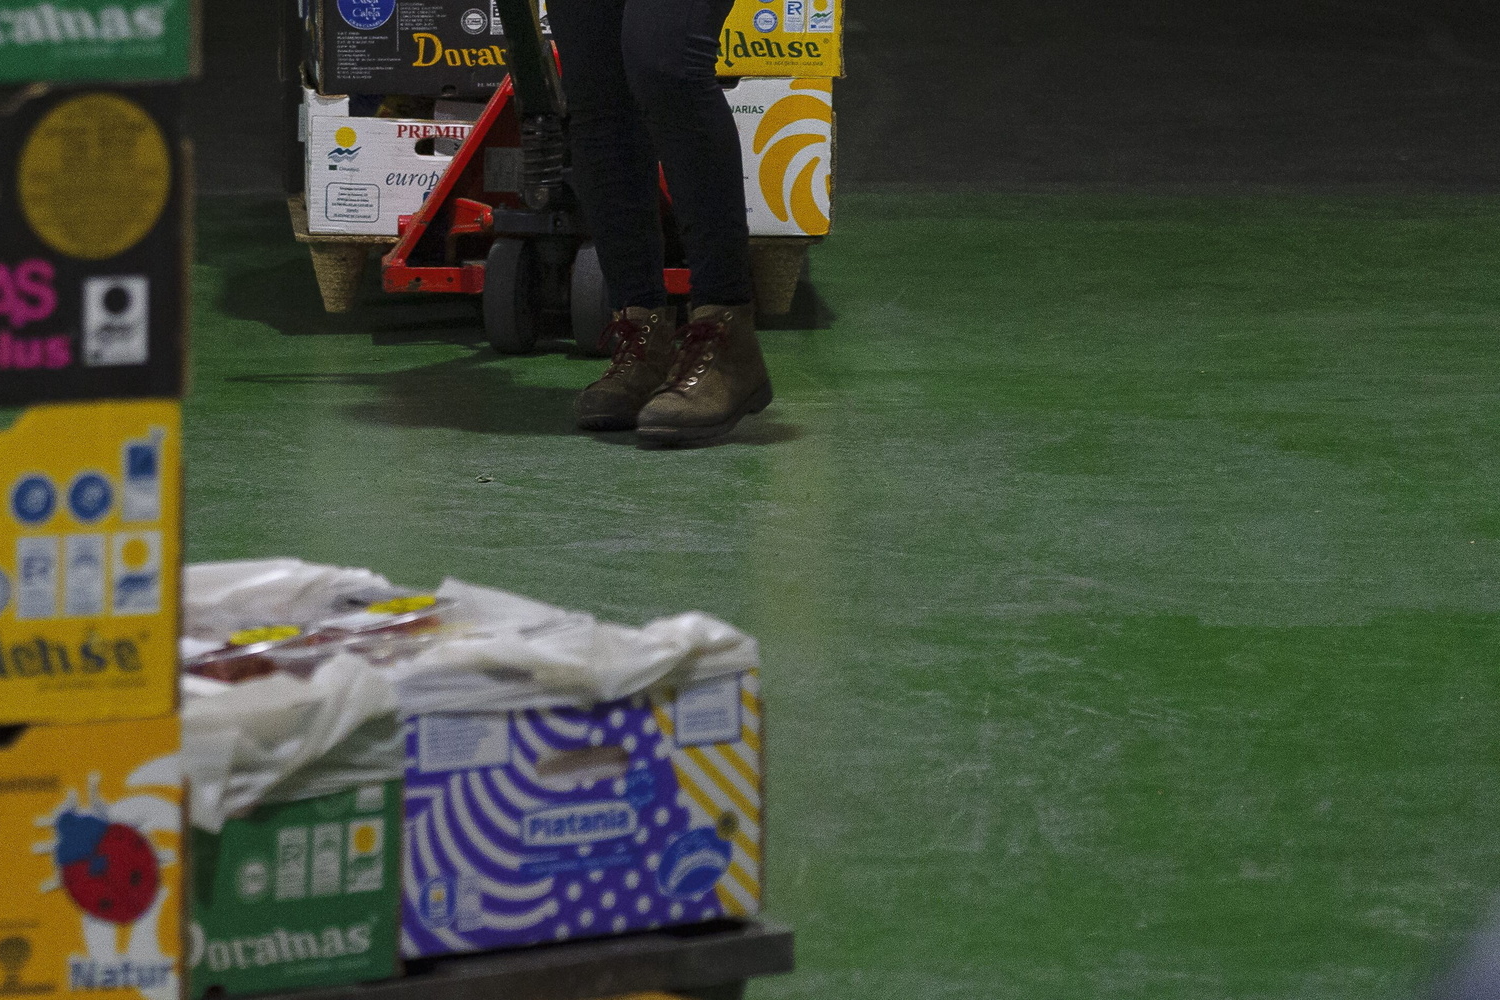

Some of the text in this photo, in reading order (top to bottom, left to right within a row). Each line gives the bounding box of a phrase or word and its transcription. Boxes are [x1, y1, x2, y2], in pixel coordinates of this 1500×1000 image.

[716, 28, 821, 67] ldense
[731, 105, 764, 114] ARIAS
[397, 124, 474, 140] PREMI
[70, 957, 174, 991] Natur
